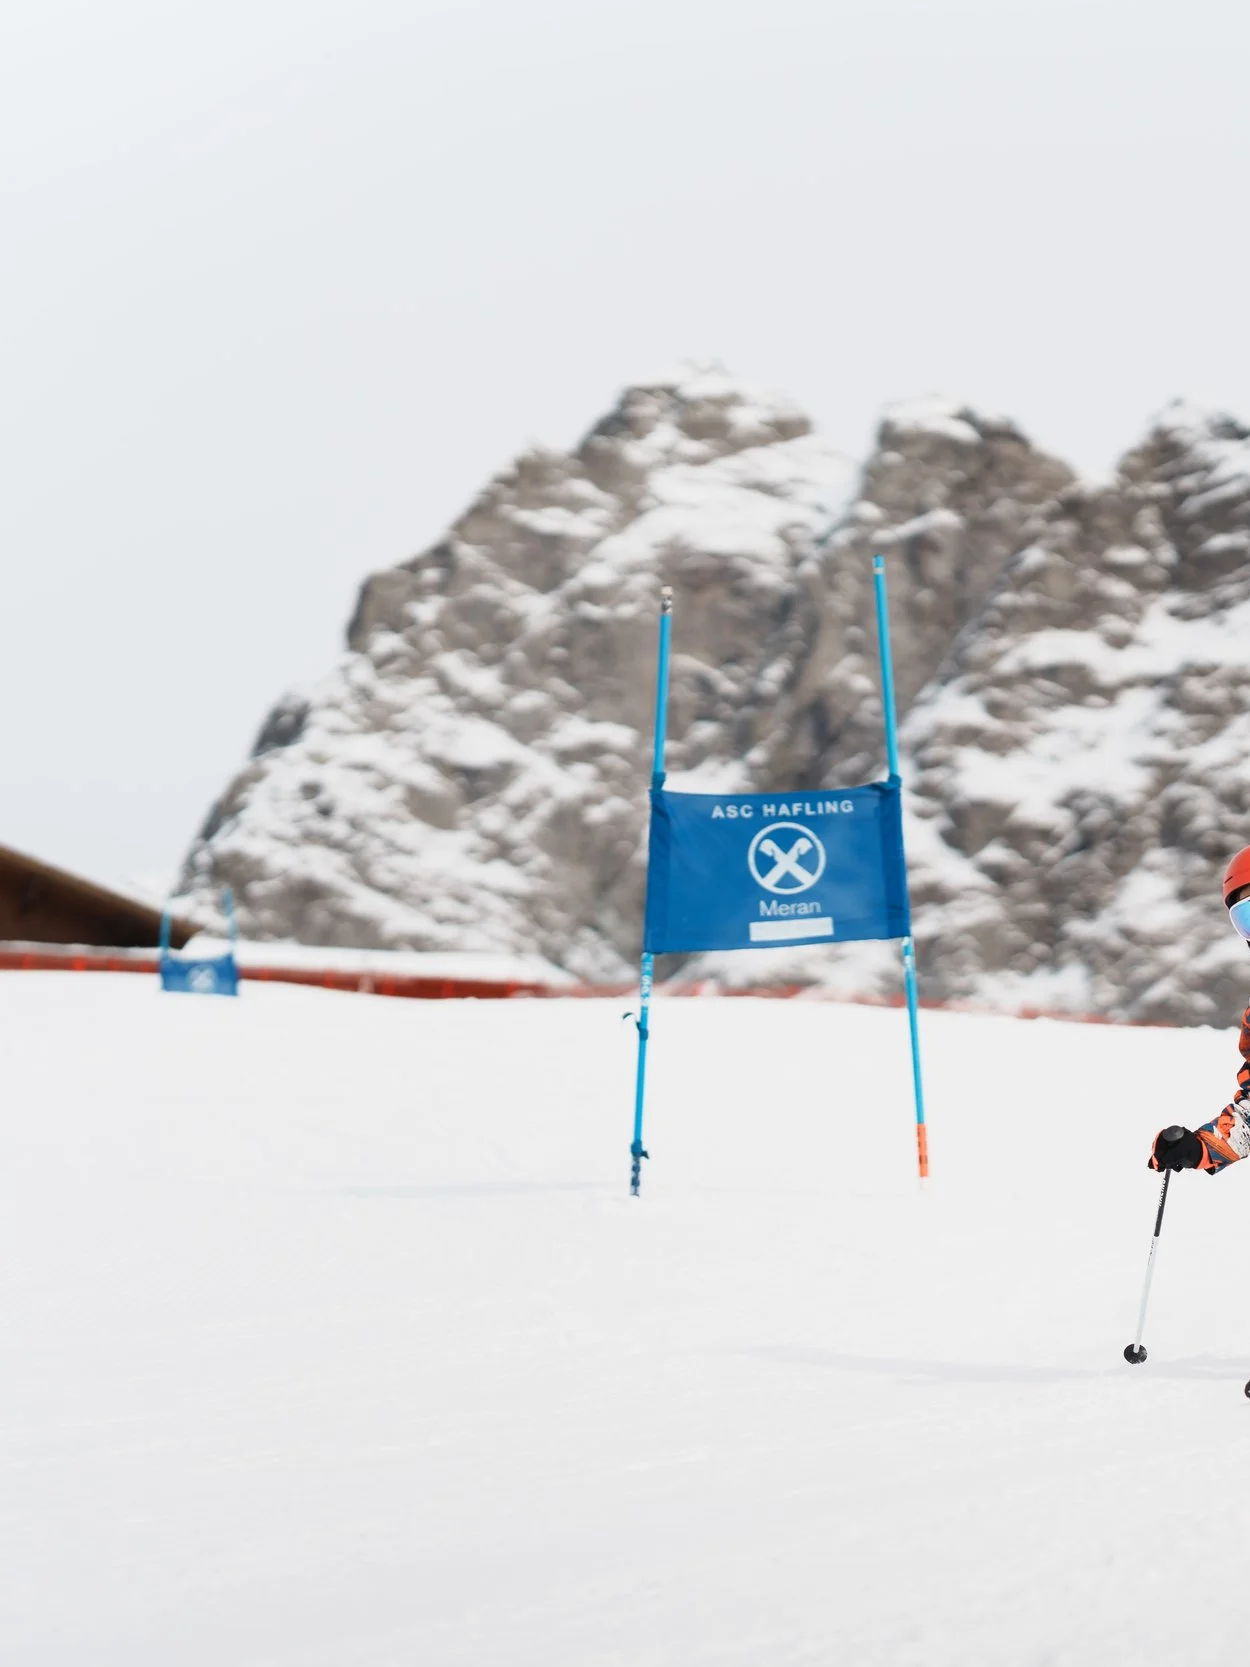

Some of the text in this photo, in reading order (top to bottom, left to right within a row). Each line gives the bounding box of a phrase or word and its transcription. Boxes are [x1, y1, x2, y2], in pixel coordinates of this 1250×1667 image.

[711, 800, 855, 819] ASC HAFLING
[759, 900, 822, 916] Meran
